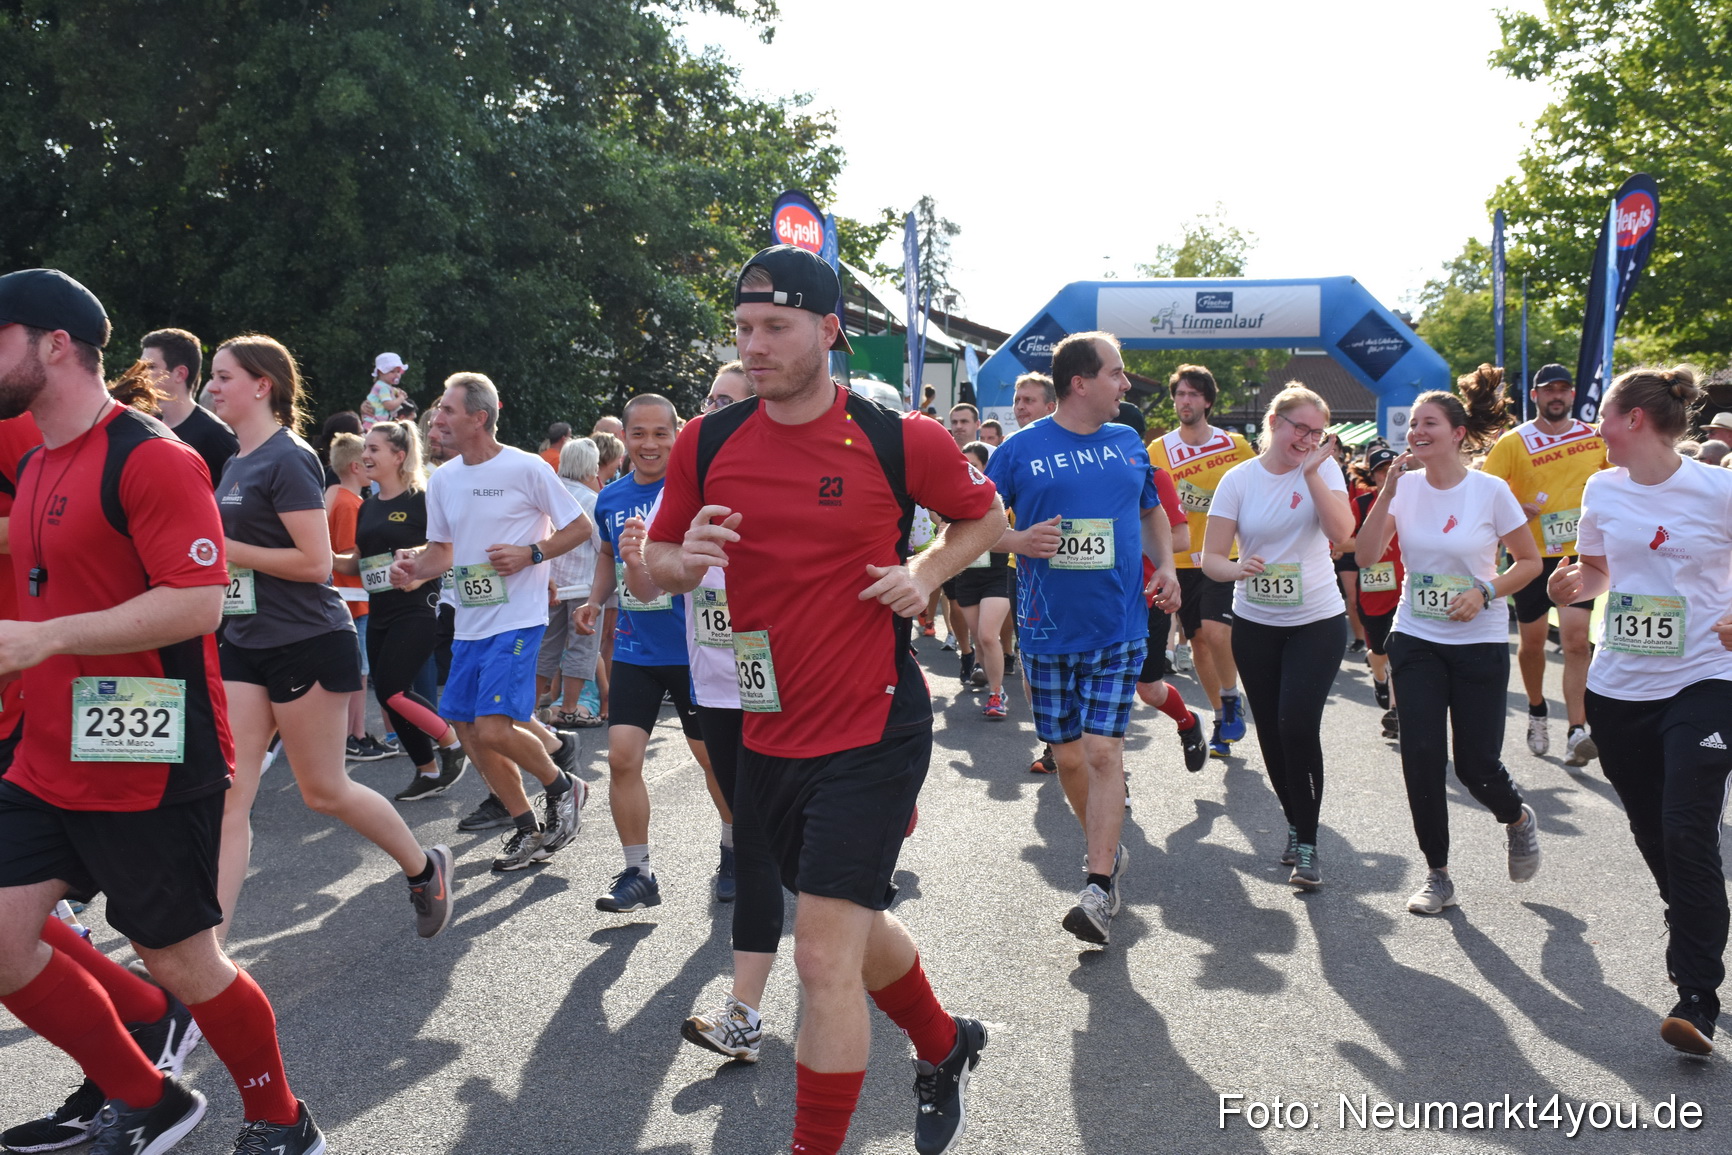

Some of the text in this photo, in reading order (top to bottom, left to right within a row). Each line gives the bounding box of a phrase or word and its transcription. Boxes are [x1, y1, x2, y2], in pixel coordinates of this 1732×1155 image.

[1616, 204, 1651, 235] Hervis
[1198, 296, 1231, 307] Fischer
[1182, 313, 1265, 329] firmenlauf
[1532, 441, 1601, 467] MAX BÖGL
[1172, 453, 1239, 482] MAX BÖGL
[472, 488, 505, 497] ALBERT
[819, 476, 844, 498] 23
[48, 494, 68, 516] 13
[1180, 492, 1210, 507] 1572
[1056, 536, 1106, 555] 2043
[366, 570, 386, 586] 9067
[1252, 577, 1294, 594] 1313
[1363, 572, 1390, 584] 2343
[464, 578, 492, 596] 653
[1614, 614, 1673, 639] 1315
[1613, 636, 1642, 644] Großmann
[85, 707, 170, 738] 2332
[101, 738, 124, 746] Finck
[1699, 741, 1728, 750] adidas
